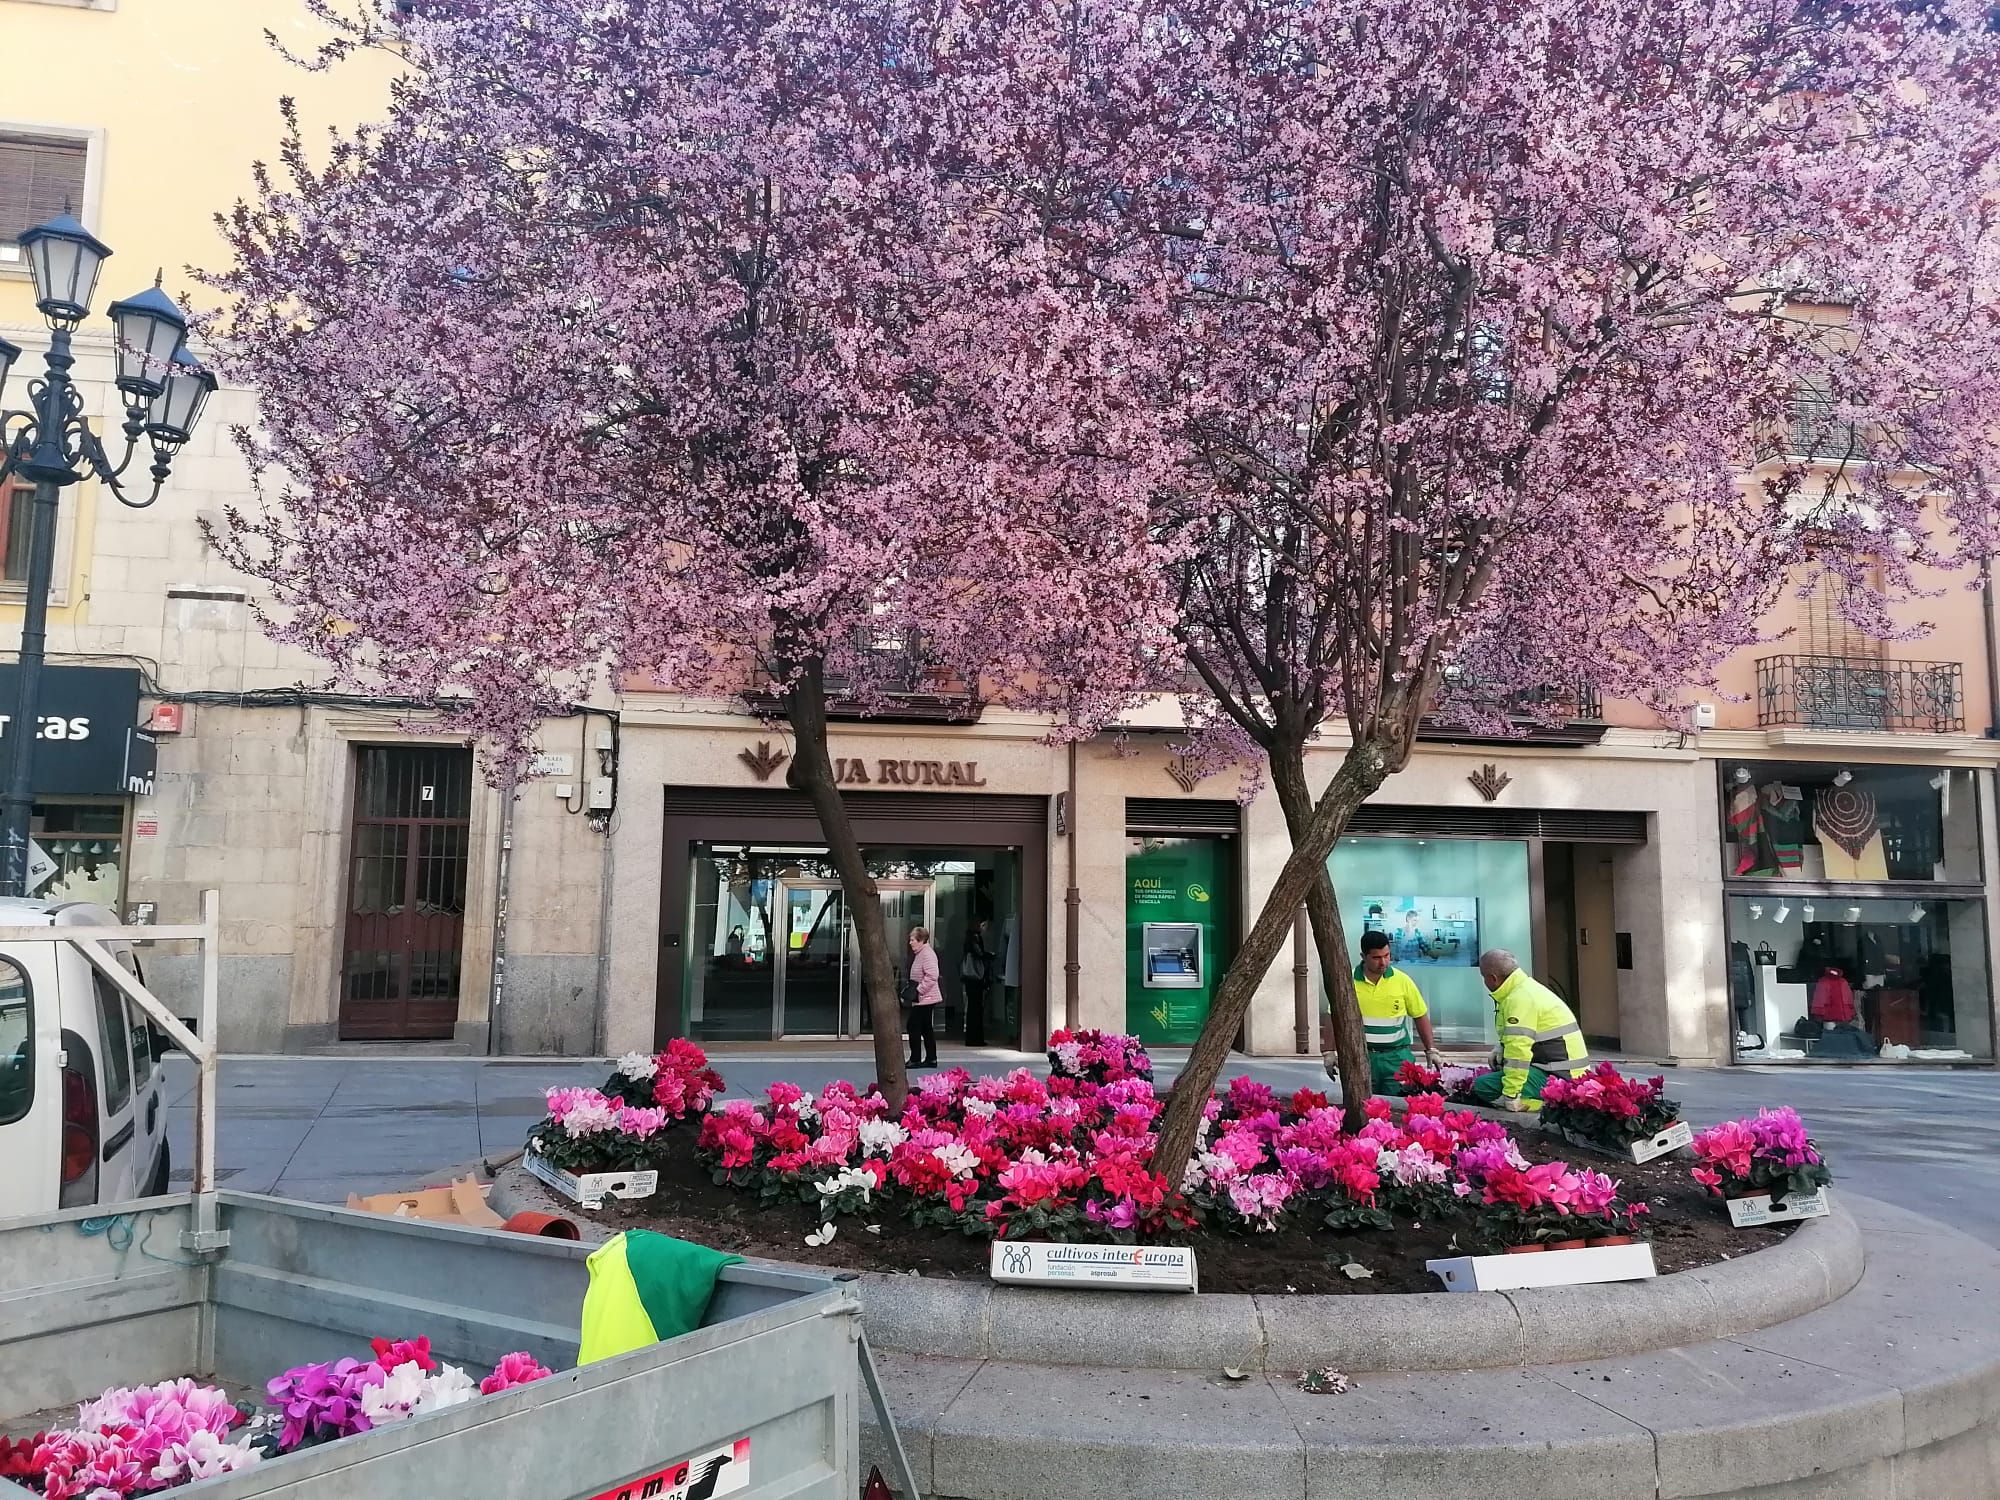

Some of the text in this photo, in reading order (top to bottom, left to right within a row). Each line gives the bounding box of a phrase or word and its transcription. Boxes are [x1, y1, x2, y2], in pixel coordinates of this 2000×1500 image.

[878, 759, 987, 787] RURAL
[424, 787, 432, 799] 7
[1134, 876, 1161, 889] AQUÍ
[1047, 1247, 1099, 1260] cultivos
